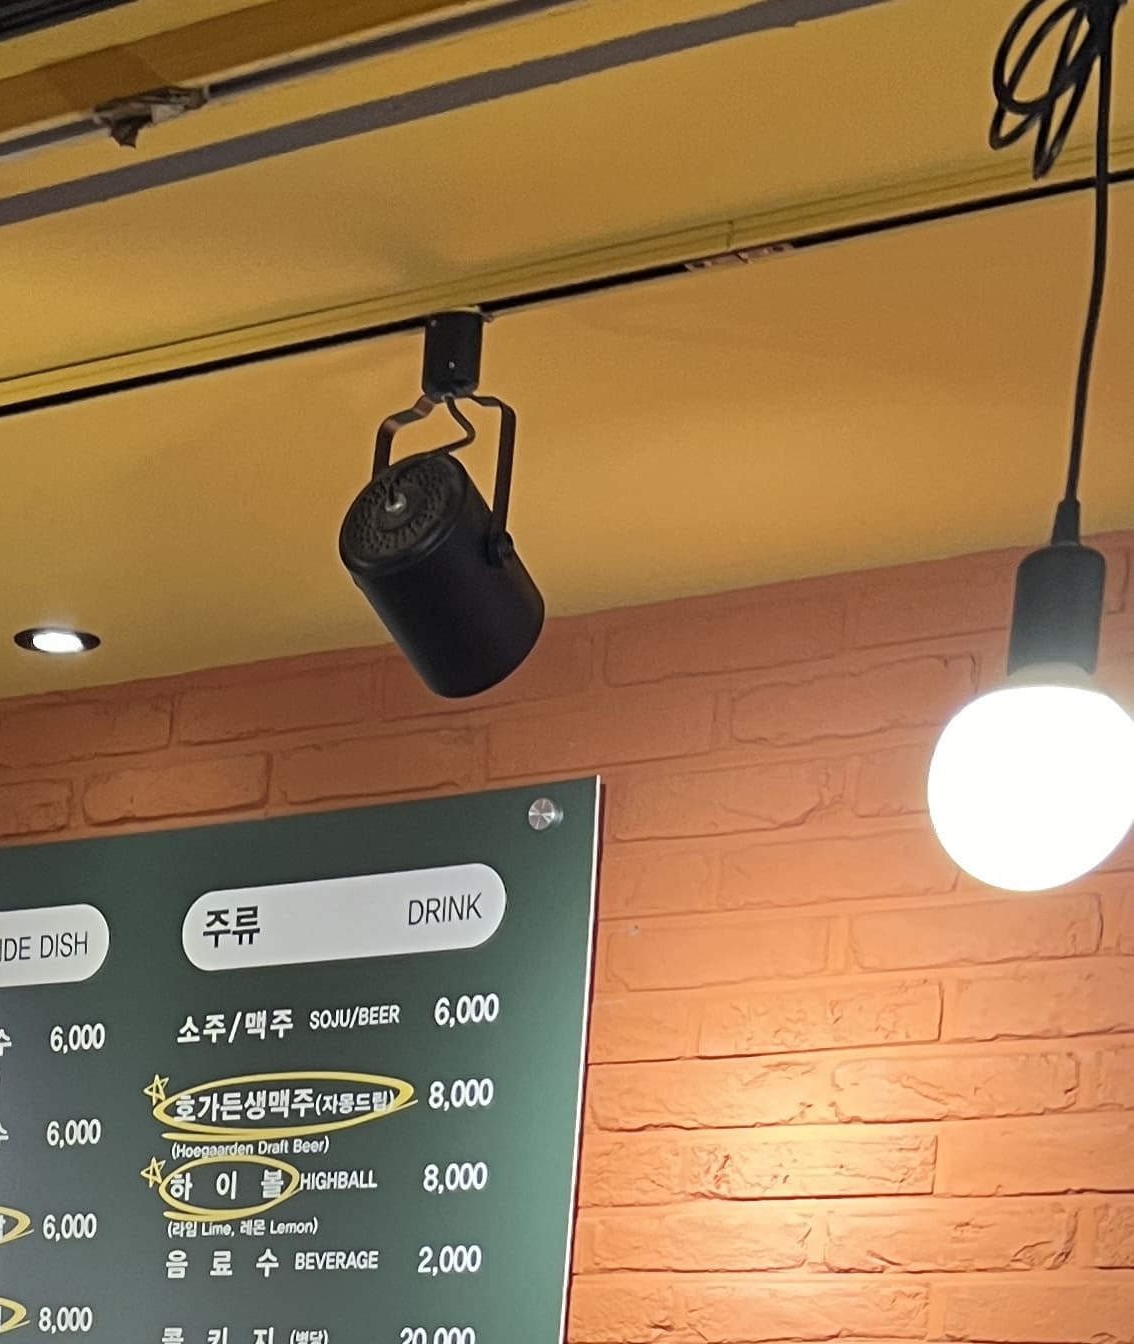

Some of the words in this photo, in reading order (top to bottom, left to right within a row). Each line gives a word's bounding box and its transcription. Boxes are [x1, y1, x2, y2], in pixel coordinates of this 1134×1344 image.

[408, 892, 482, 926] DRINK
[202, 905, 261, 948] 주류
[40, 930, 88, 959] DISH
[177, 1008, 294, 1044] 소주/맥주
[309, 1004, 400, 1031] SOJU/BEER
[434, 993, 500, 1029] 6,000
[50, 1023, 106, 1054] 6,000
[428, 1078, 494, 1112] 8,000
[46, 1118, 102, 1149] 6,000
[170, 1140, 254, 1160] (Hoegaarden
[258, 1138, 289, 1157] Draft
[293, 1136, 330, 1156] Beer)
[298, 1170, 378, 1192] HIGHBALL
[422, 1161, 488, 1195] 8,000
[42, 1213, 97, 1242] 6,000
[201, 1221, 235, 1239] Lime,
[270, 1216, 318, 1236] Lemon)
[294, 1250, 380, 1271] BEVERAGE
[418, 1245, 482, 1278] 2,000
[38, 1306, 93, 1335] 8,000
